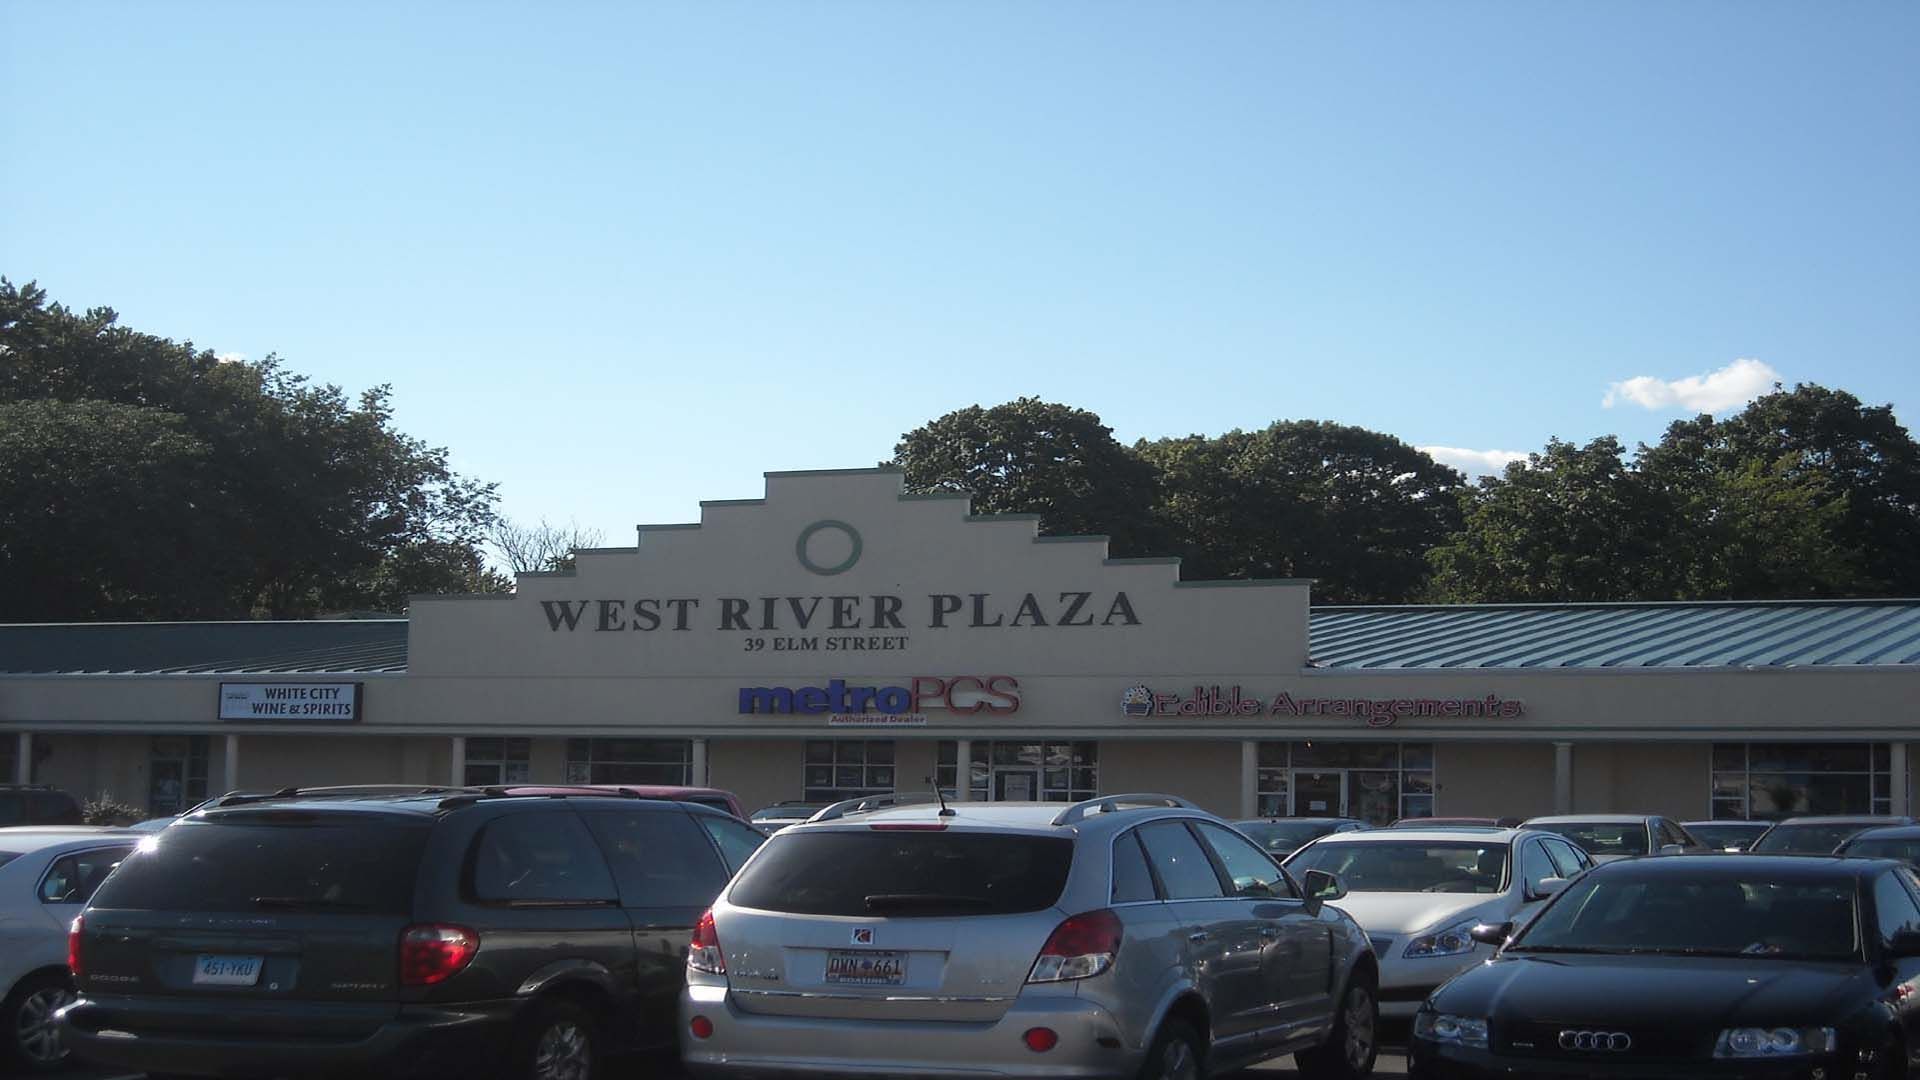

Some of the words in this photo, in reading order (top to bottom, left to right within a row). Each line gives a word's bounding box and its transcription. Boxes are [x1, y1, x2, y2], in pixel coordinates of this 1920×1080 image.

[540, 599, 699, 632] WEST
[717, 595, 906, 631] RIVER
[928, 591, 1142, 628] PLAZA
[744, 638, 765, 651] 39
[773, 637, 819, 650] ELM
[825, 636, 909, 650] STREET
[265, 688, 307, 699] WHITE
[309, 688, 340, 699] CITY
[739, 676, 1020, 715] metroPCS
[252, 703, 286, 714] WINE
[289, 705, 300, 714] &
[303, 704, 351, 715] SPIRITS
[1153, 686, 1261, 717] Edible
[1271, 692, 1522, 727] Arrangements
[831, 714, 887, 724] Authorized
[889, 714, 926, 724] Dealer
